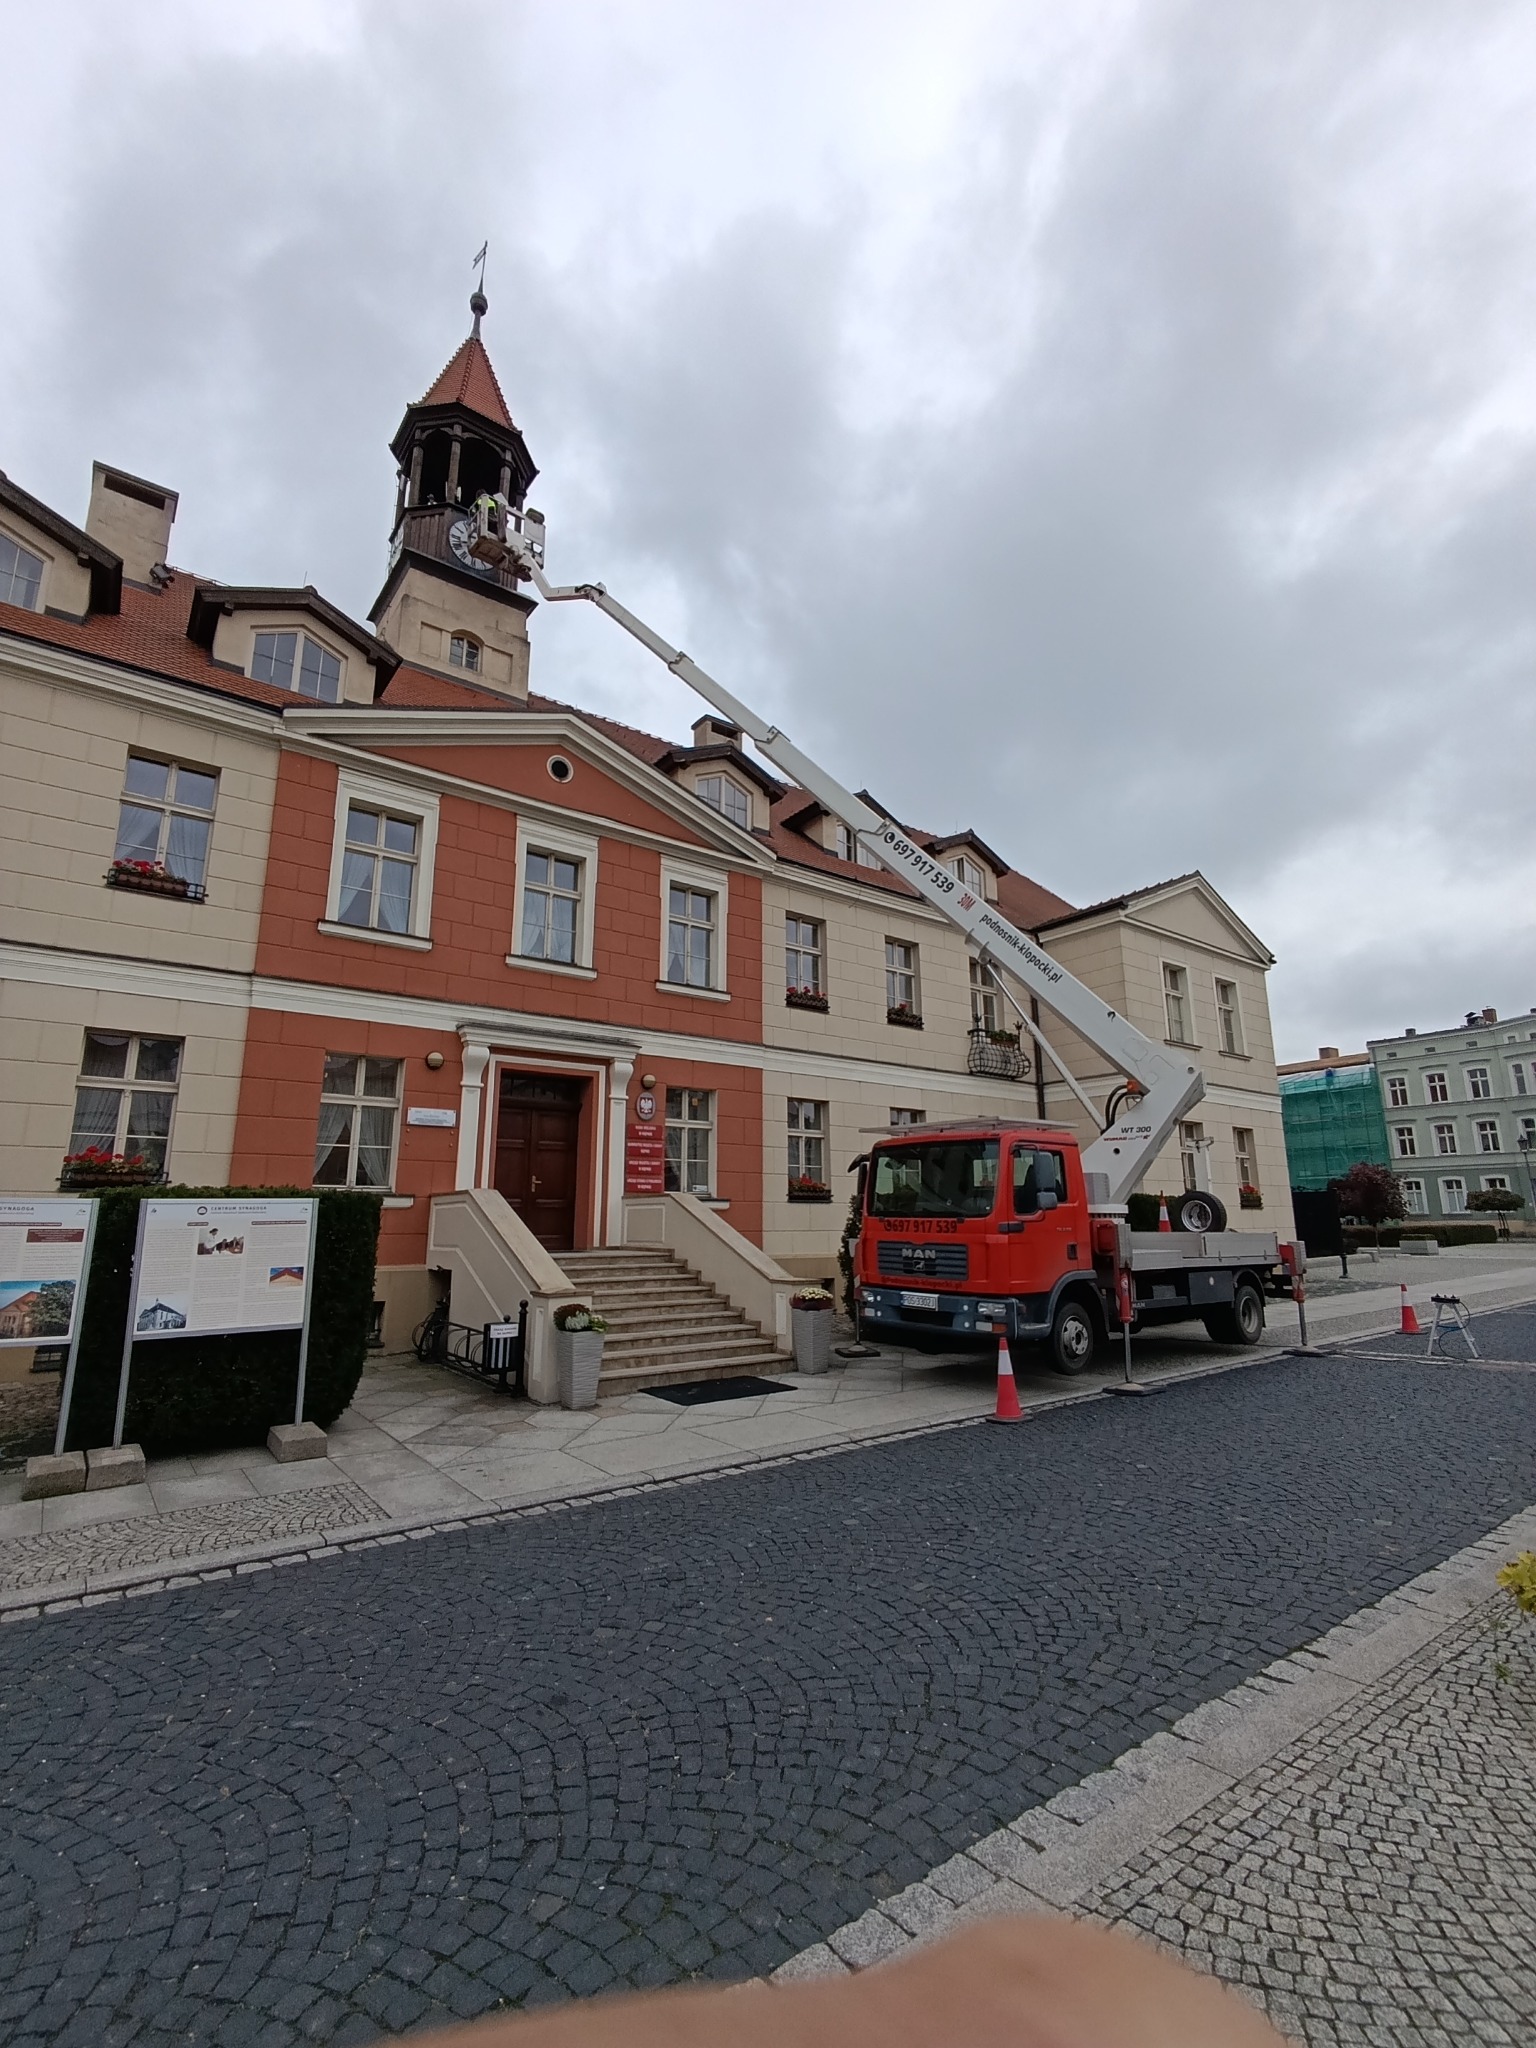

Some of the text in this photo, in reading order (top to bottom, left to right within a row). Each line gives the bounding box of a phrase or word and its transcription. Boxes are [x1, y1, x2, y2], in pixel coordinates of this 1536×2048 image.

[893, 840, 955, 893] 697 917 539
[979, 914, 1063, 983] podnosnik-klopocki.pl
[892, 1219, 957, 1233] 697 917 539
[902, 1248, 936, 1258] MAN
